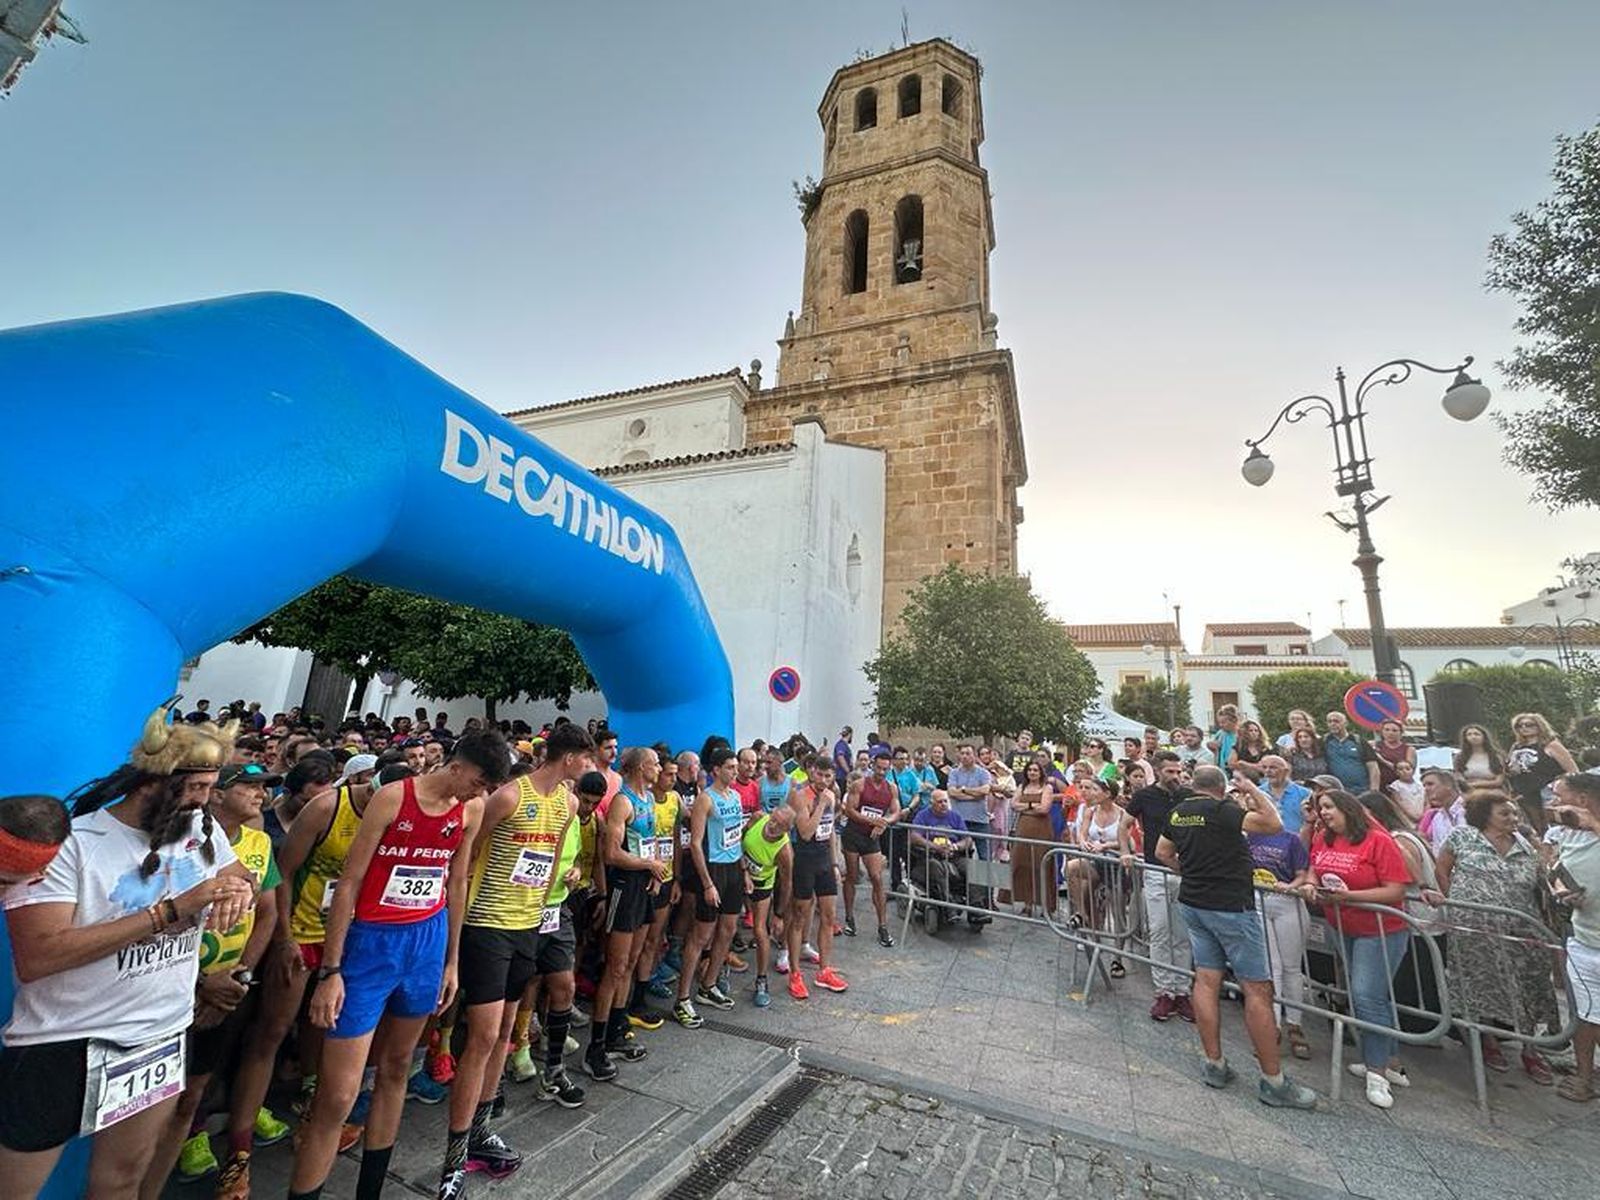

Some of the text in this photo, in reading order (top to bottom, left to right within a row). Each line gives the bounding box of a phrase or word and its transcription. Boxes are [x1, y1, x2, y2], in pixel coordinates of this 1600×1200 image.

[440, 408, 664, 575] DECATHLON
[378, 844, 408, 857] SAN
[524, 862, 549, 878] 295
[400, 879, 434, 896] 382
[117, 943, 157, 972] Vive
[123, 1062, 167, 1098] 119
